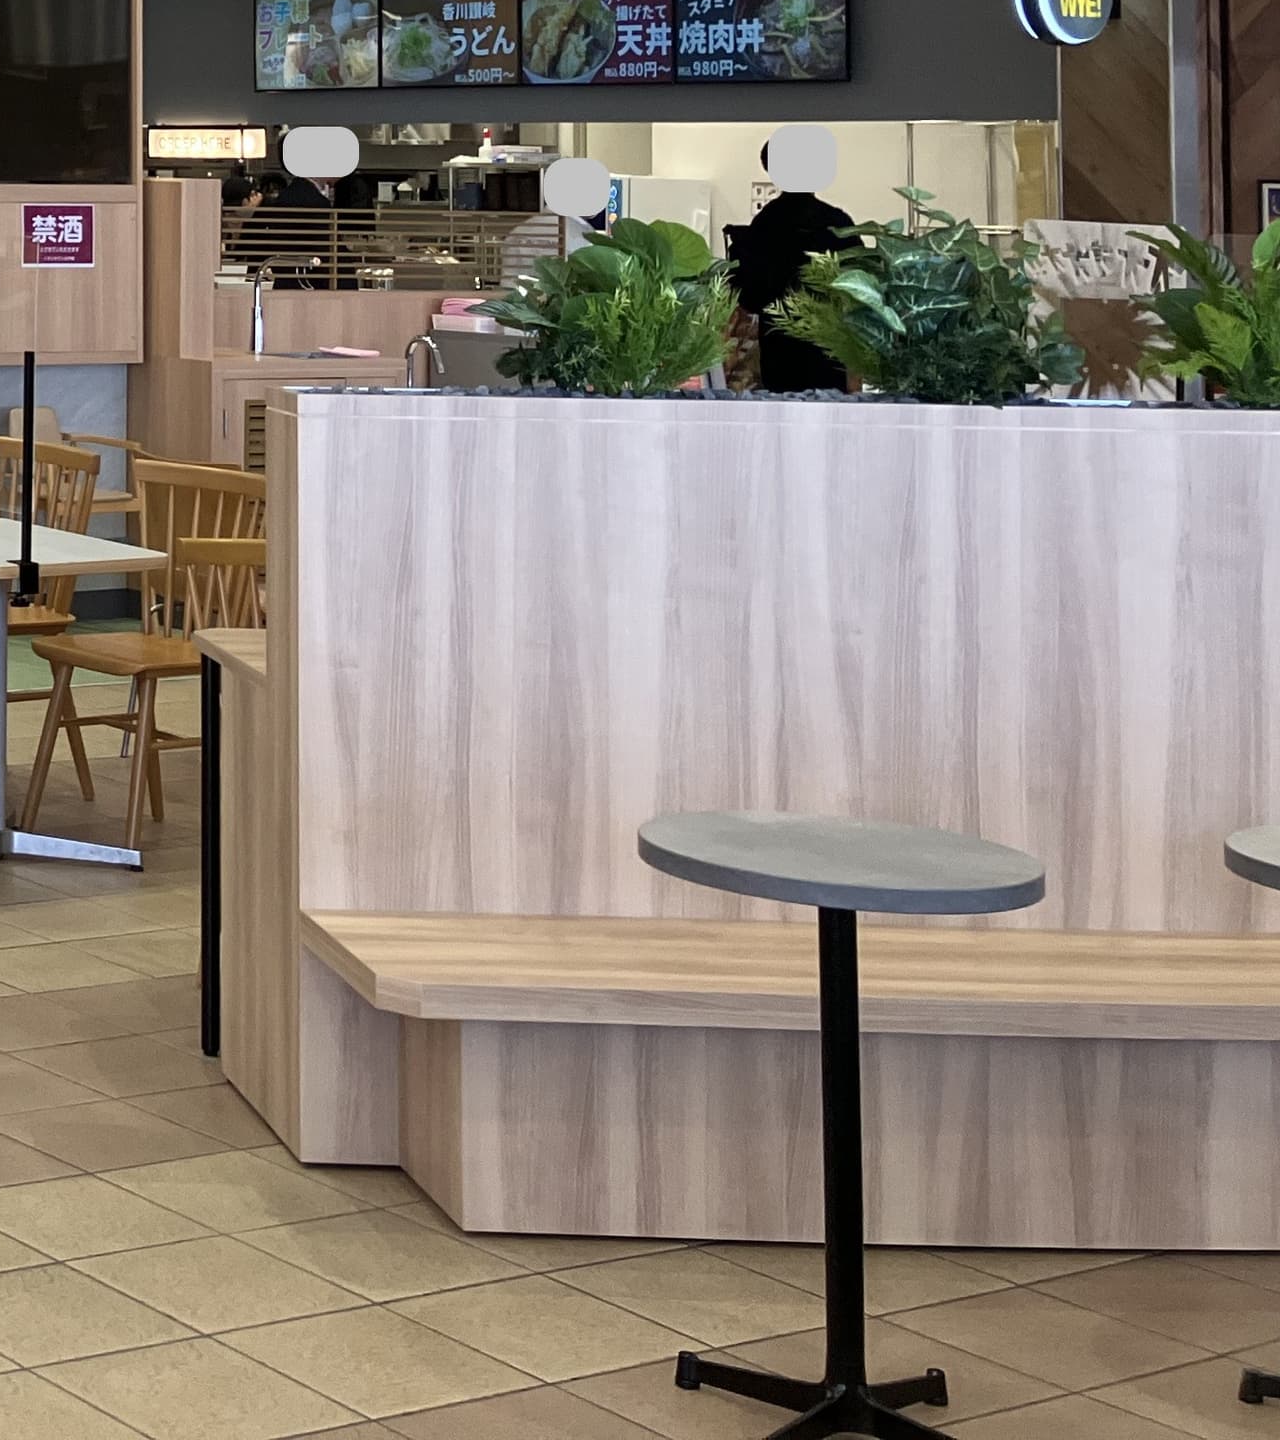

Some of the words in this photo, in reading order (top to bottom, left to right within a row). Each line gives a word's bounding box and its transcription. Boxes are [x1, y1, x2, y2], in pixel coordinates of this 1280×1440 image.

[449, 25, 515, 57] うどん
[617, 22, 672, 57] 天丼
[679, 18, 765, 55] 焼肉丼
[32, 214, 83, 243] 禁酒
